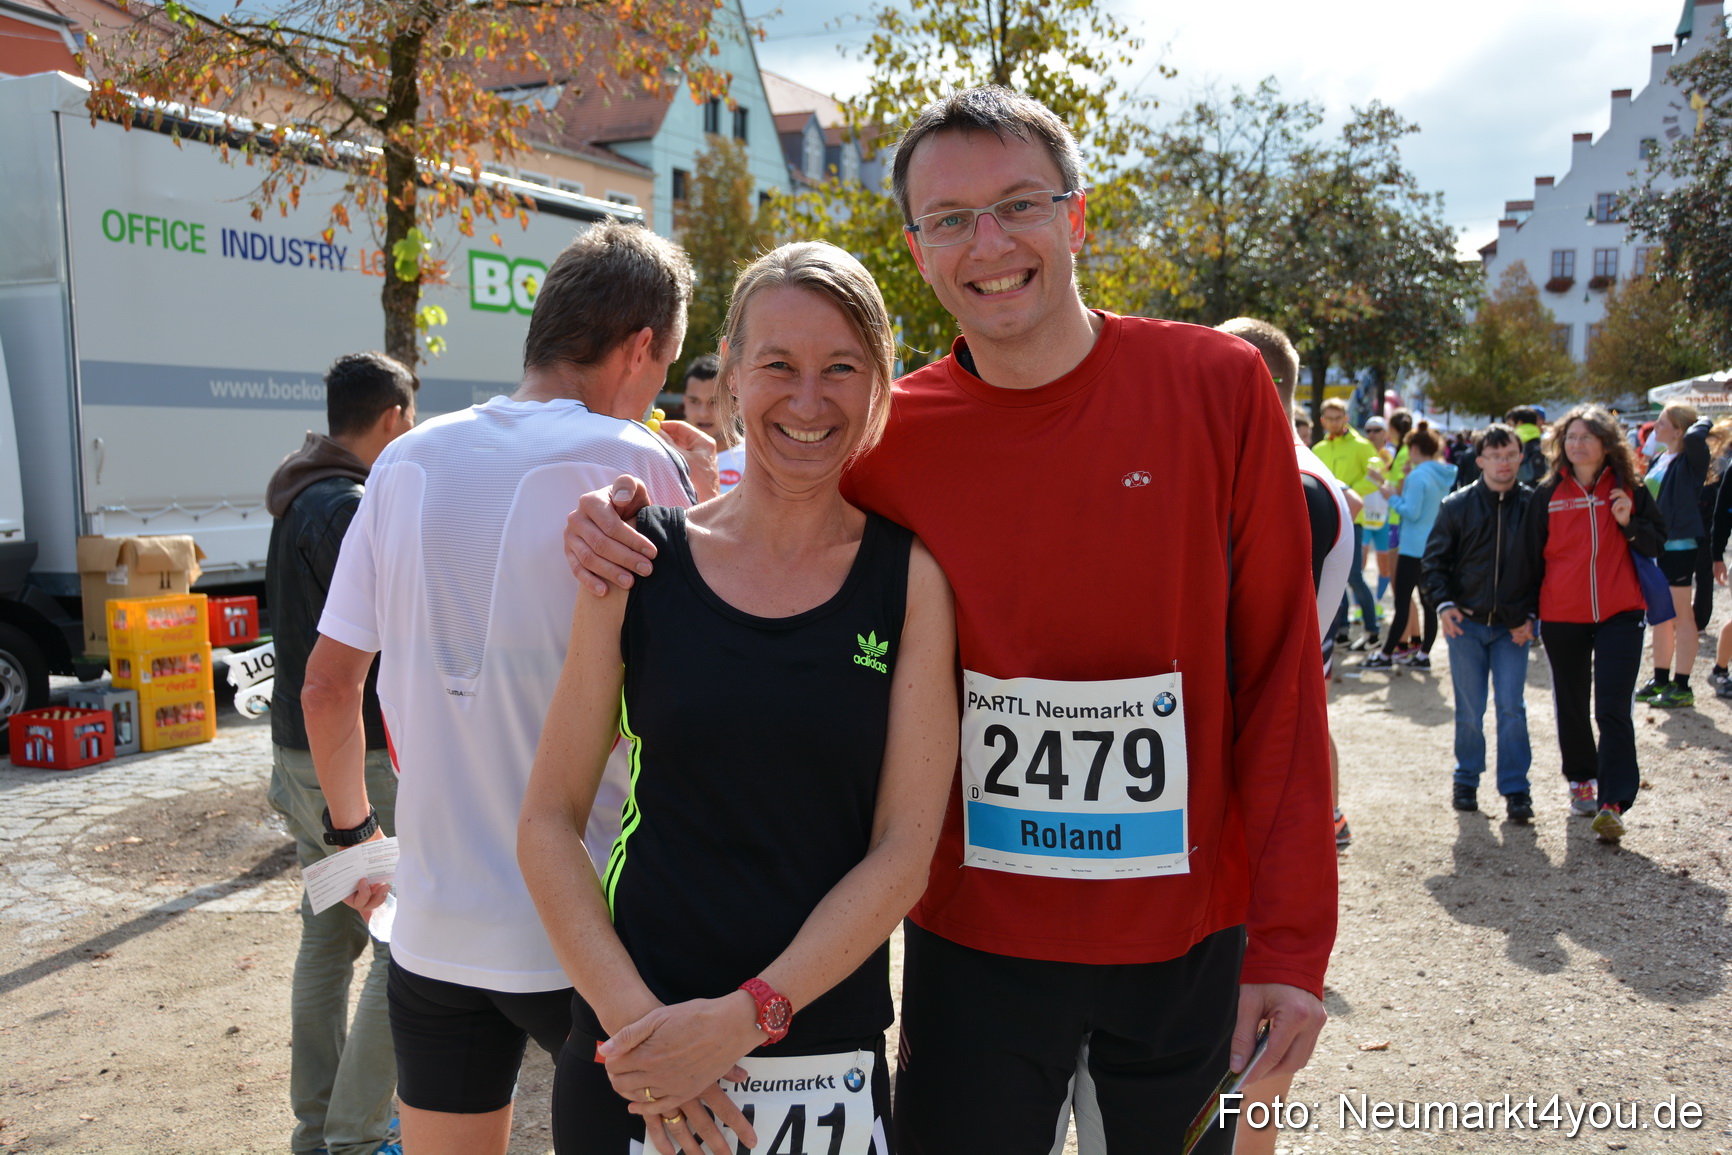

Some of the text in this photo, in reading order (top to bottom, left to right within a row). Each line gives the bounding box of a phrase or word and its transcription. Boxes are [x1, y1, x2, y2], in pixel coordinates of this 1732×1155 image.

[102, 209, 206, 254] OFFICE
[221, 228, 347, 273] INDUSTRY
[468, 250, 547, 315] BO
[209, 376, 327, 402] www.bocko
[240, 652, 276, 679] ort
[853, 654, 888, 674] adidas
[967, 691, 1144, 719] PARTL Neumarkt
[983, 723, 1166, 803] 2479
[971, 786, 979, 799] D
[1020, 819, 1122, 851] Roland
[734, 1074, 836, 1093] Neumarkt
[680, 1102, 846, 1155] 141
